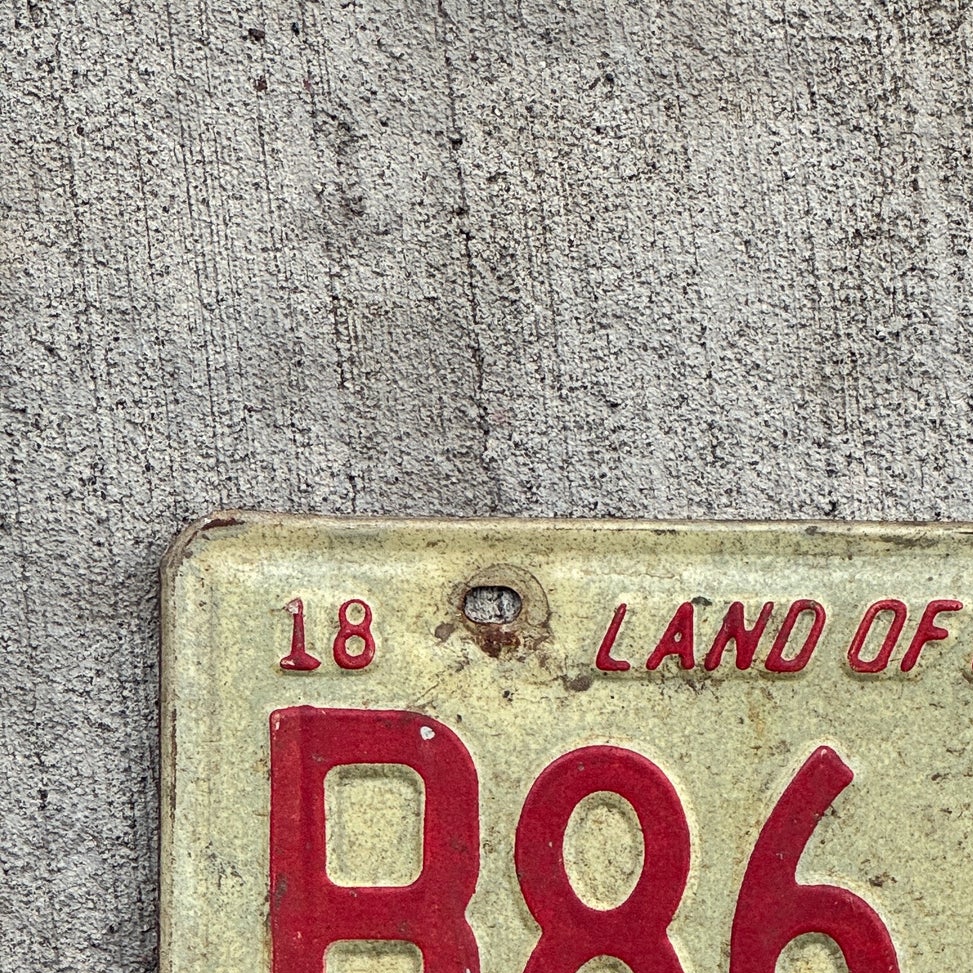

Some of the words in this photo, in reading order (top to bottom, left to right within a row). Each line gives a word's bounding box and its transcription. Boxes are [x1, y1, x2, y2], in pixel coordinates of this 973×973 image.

[279, 598, 377, 672] 18
[595, 600, 828, 674] LAND
[848, 599, 963, 674] OF
